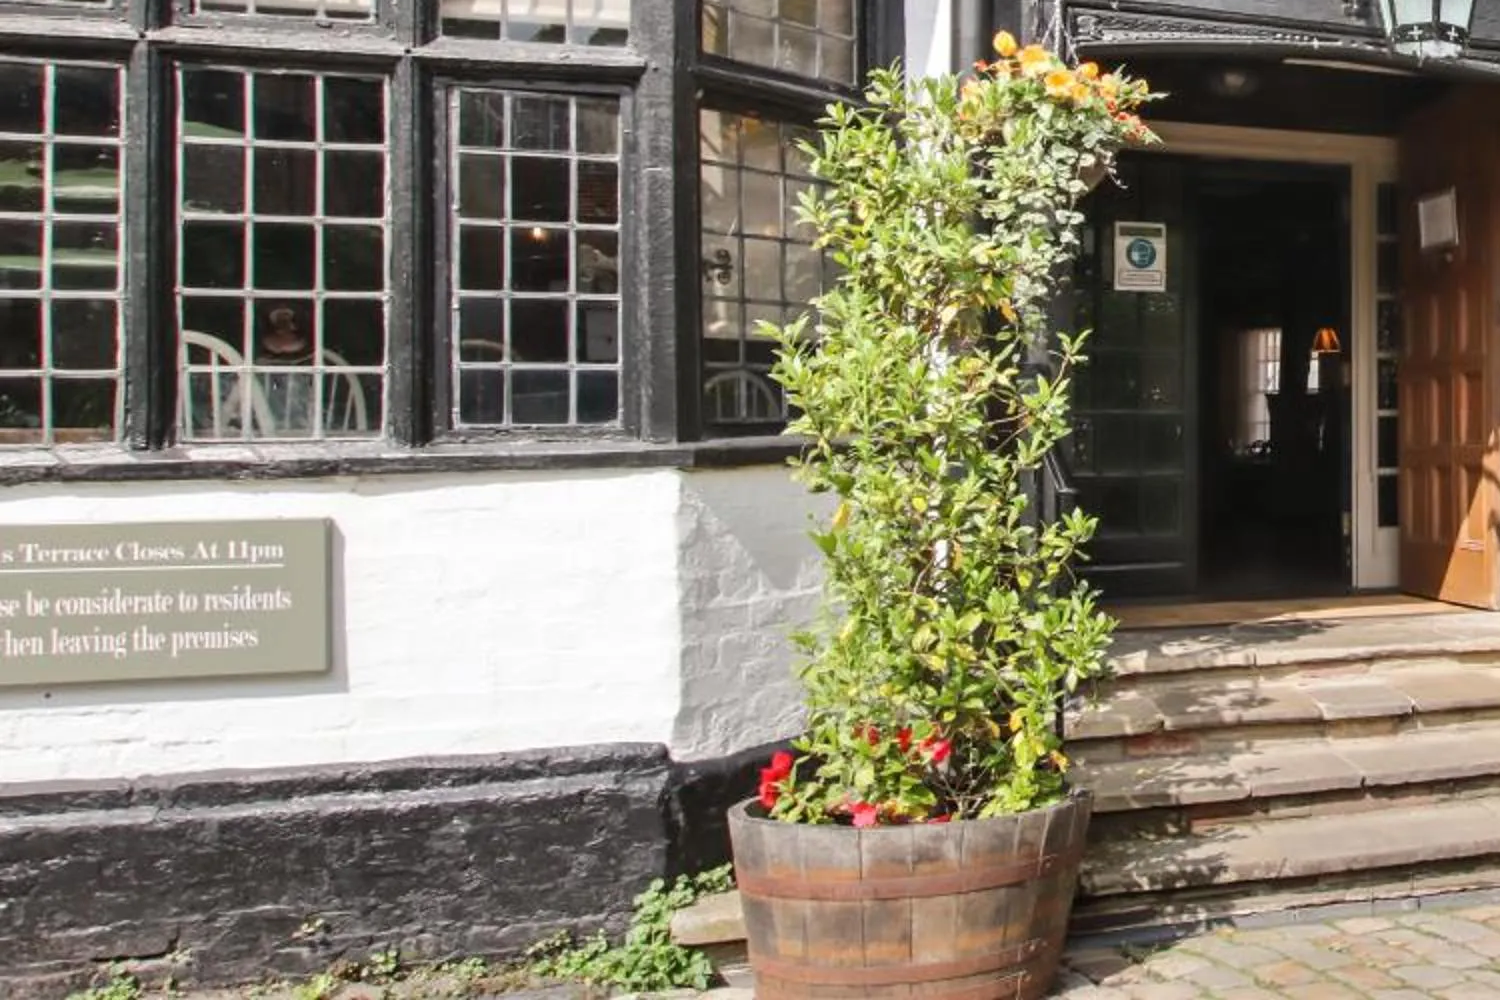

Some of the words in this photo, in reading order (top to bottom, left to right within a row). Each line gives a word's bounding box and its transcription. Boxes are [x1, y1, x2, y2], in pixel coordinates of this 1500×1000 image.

[18, 543, 110, 562] Terrace
[115, 541, 185, 561] Closes
[190, 540, 218, 559] At
[228, 540, 284, 563] 11pm
[26, 589, 50, 617] be
[55, 587, 174, 616] considerate
[179, 590, 199, 613] to
[204, 584, 292, 612] residents
[0, 629, 44, 656] hen
[51, 625, 127, 659] leaving
[132, 624, 166, 651] the
[171, 622, 259, 658] premises
